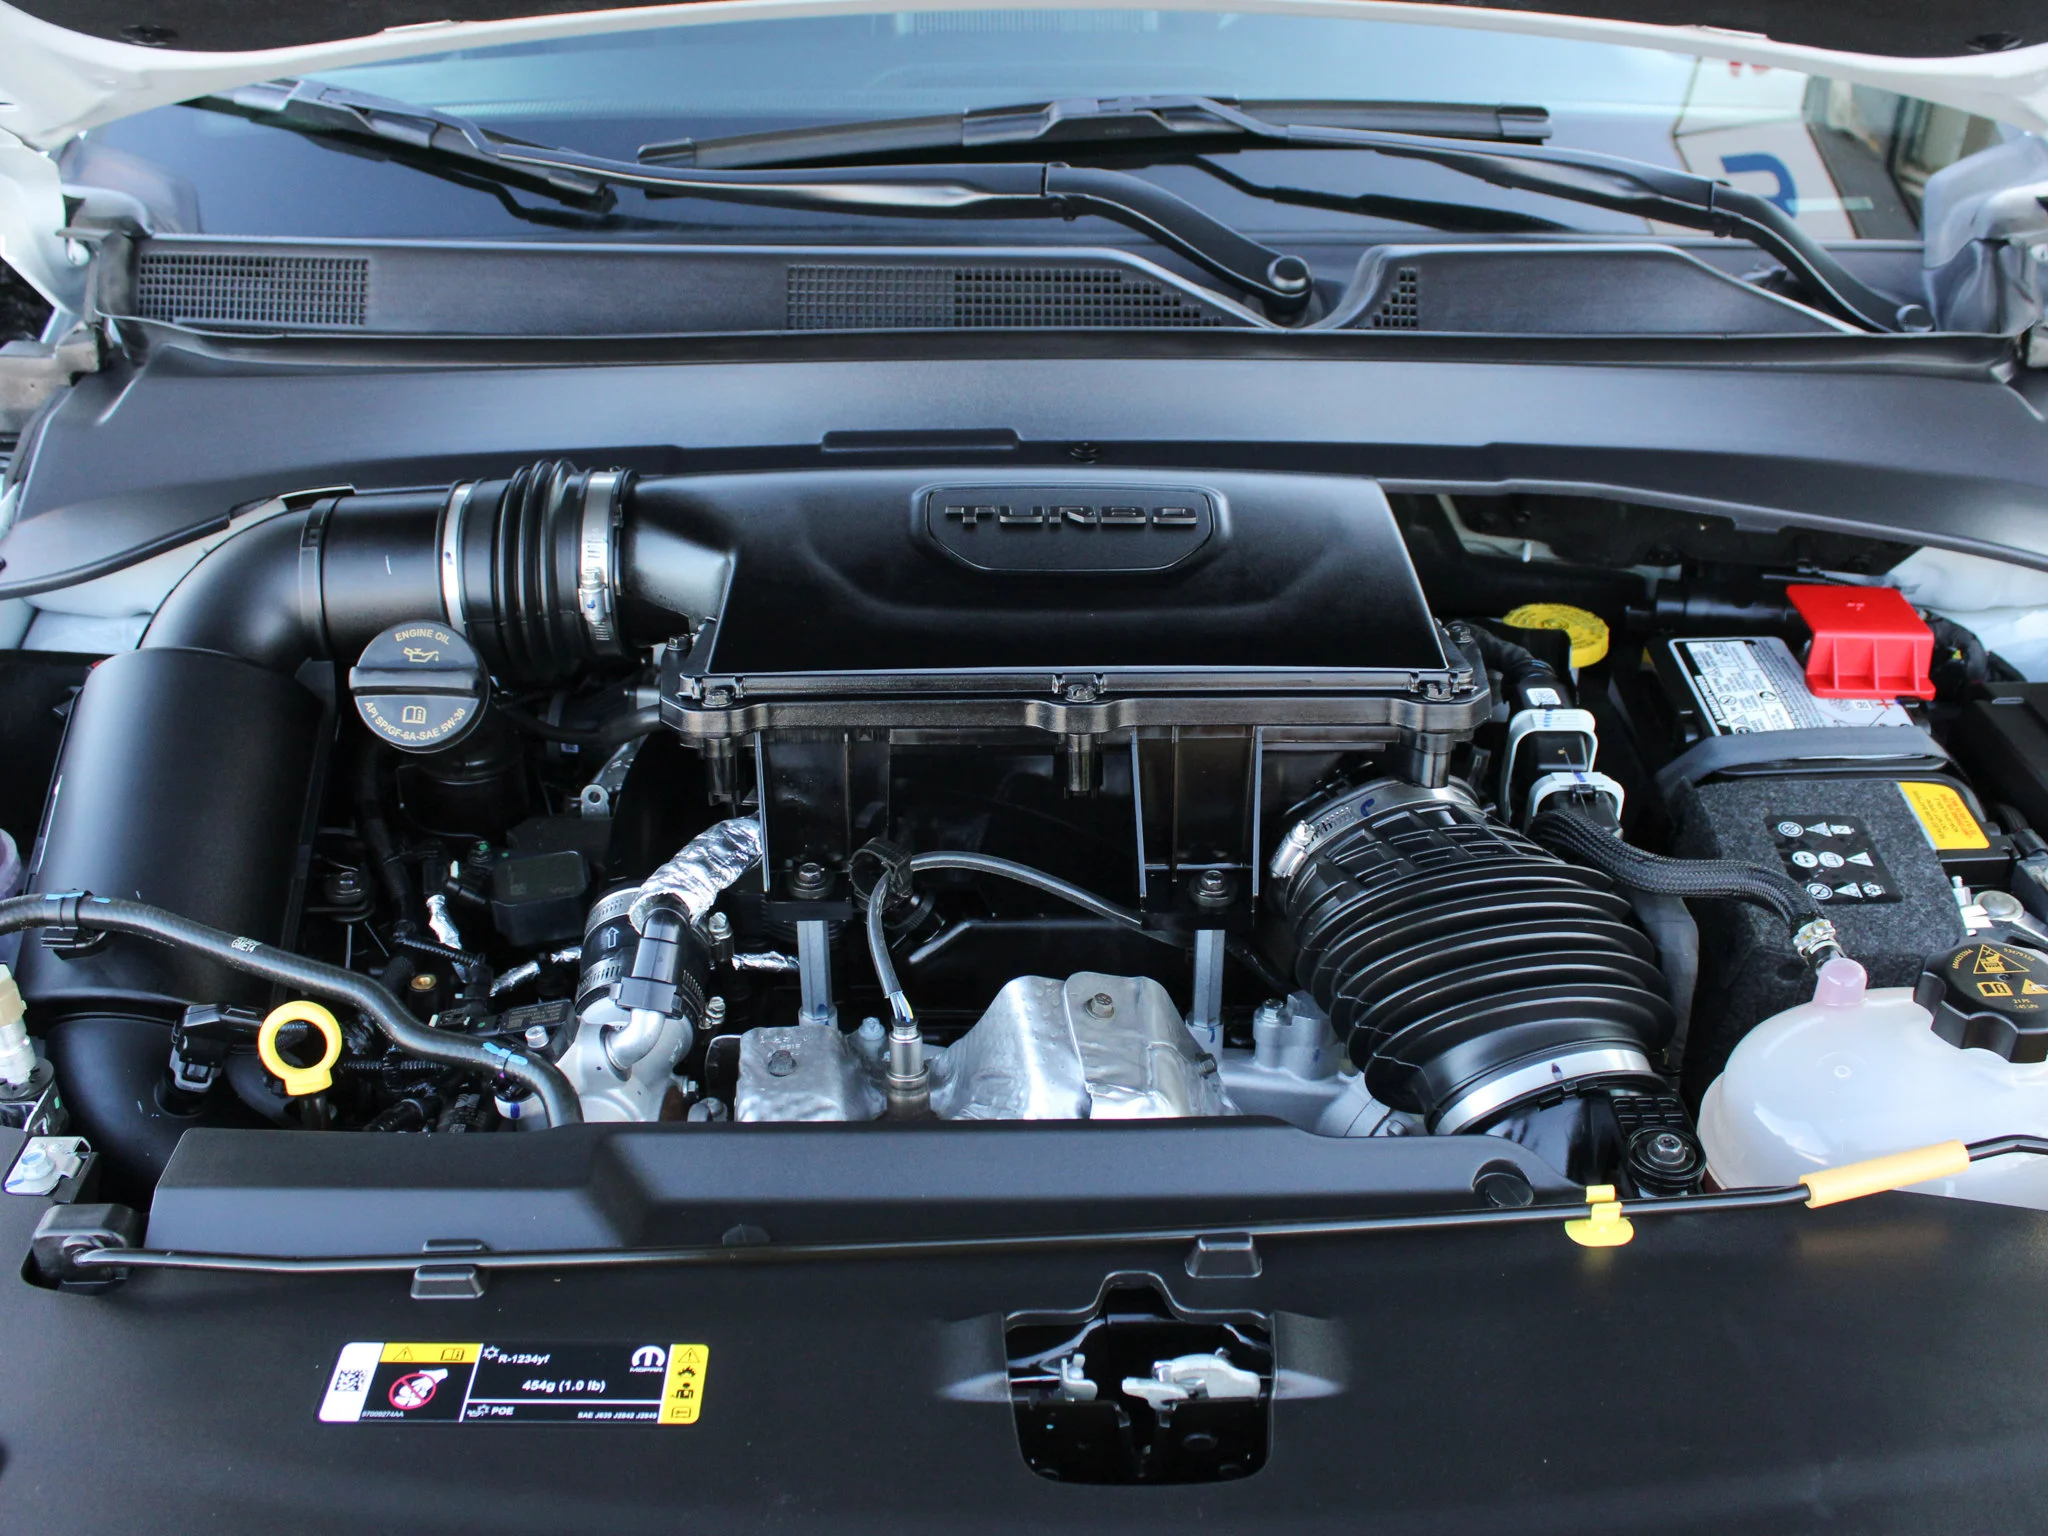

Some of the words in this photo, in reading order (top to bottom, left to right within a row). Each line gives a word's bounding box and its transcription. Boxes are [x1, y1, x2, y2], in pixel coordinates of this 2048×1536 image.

[944, 503, 1198, 527] TURBO
[394, 628, 434, 642] ENGINE
[435, 630, 451, 645] OIL
[364, 701, 379, 719] API
[441, 707, 466, 733] 5W-30
[498, 1353, 550, 1366] R-1234yf
[521, 1379, 556, 1394] 454g
[559, 1379, 585, 1393] (1.0
[587, 1379, 607, 1393] lb)
[491, 1406, 515, 1416] POE
[577, 1411, 594, 1419] SAE
